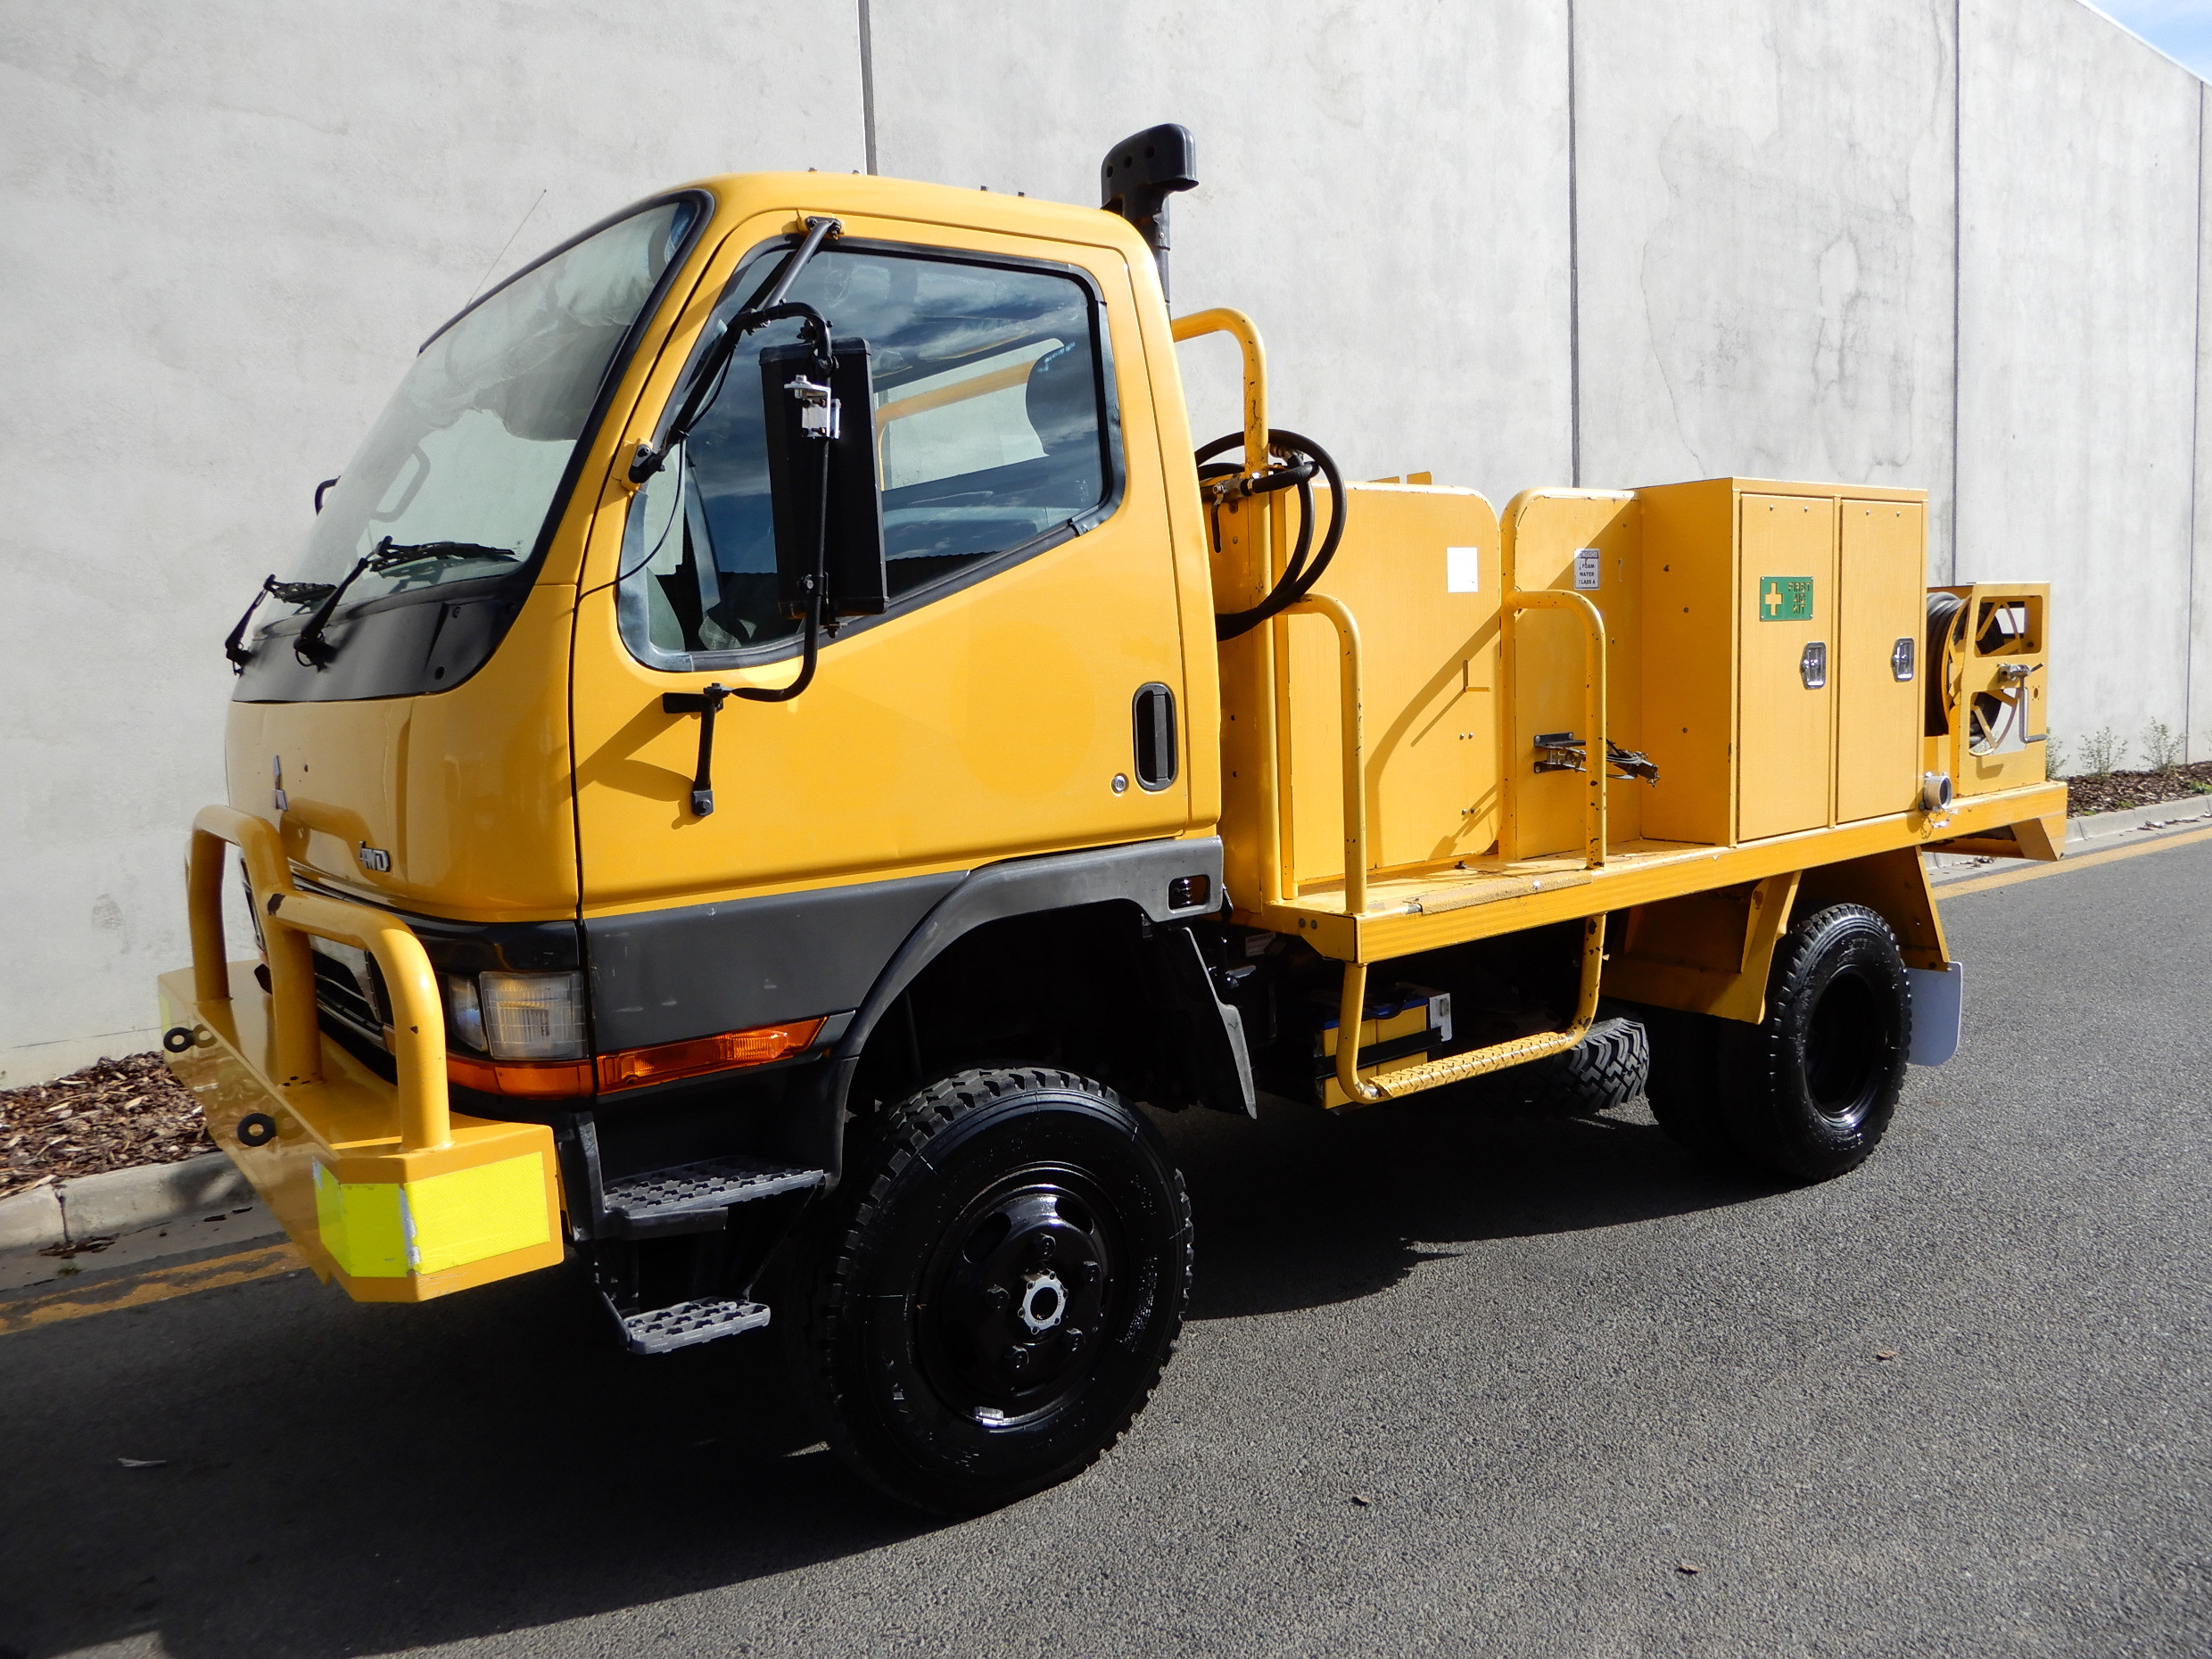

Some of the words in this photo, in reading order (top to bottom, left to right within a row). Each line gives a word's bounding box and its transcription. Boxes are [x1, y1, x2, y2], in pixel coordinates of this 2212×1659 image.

[1787, 582, 1812, 592] FIRST
[1793, 592, 1806, 603] AID
[1793, 604, 1806, 614] KIT
[359, 840, 391, 872] 4WD
